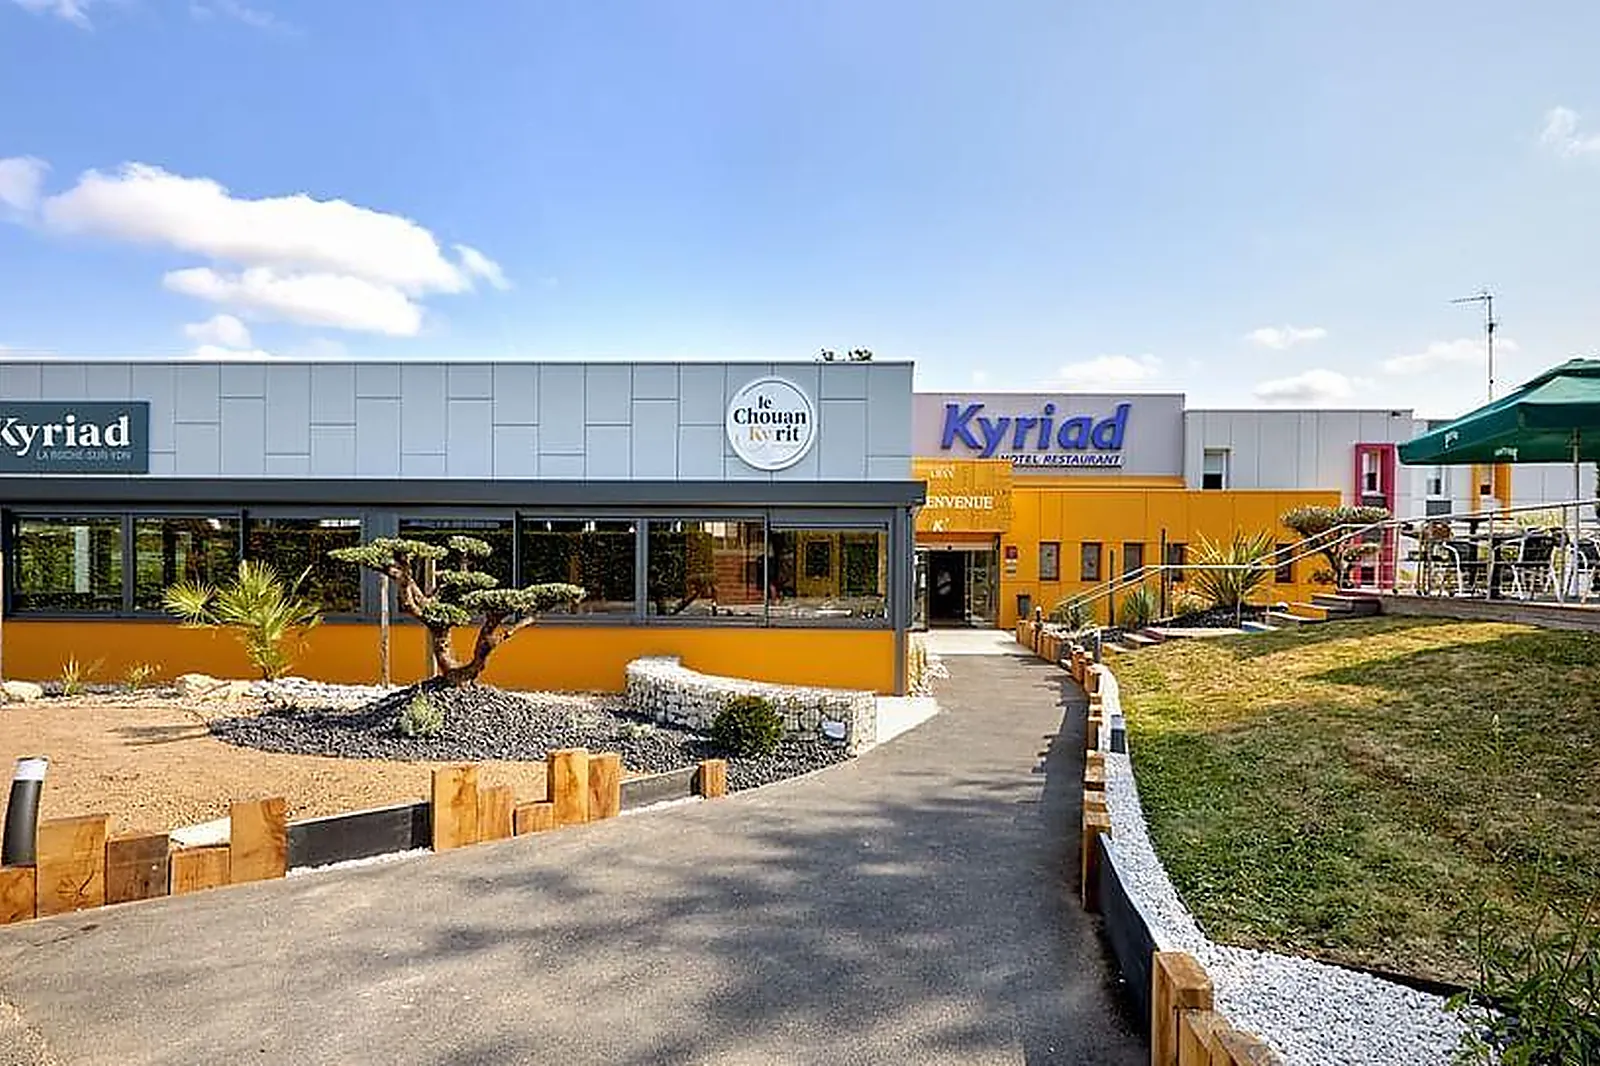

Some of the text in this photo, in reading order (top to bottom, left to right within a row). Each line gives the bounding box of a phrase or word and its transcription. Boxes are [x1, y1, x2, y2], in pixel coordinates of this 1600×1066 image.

[758, 395, 772, 409] le
[733, 407, 807, 425] Chouan
[0, 414, 131, 456] Kyriad
[940, 402, 1133, 458] Kyriad
[1042, 454, 1121, 464] RESTAURANT
[925, 495, 994, 510] ENVENUE
